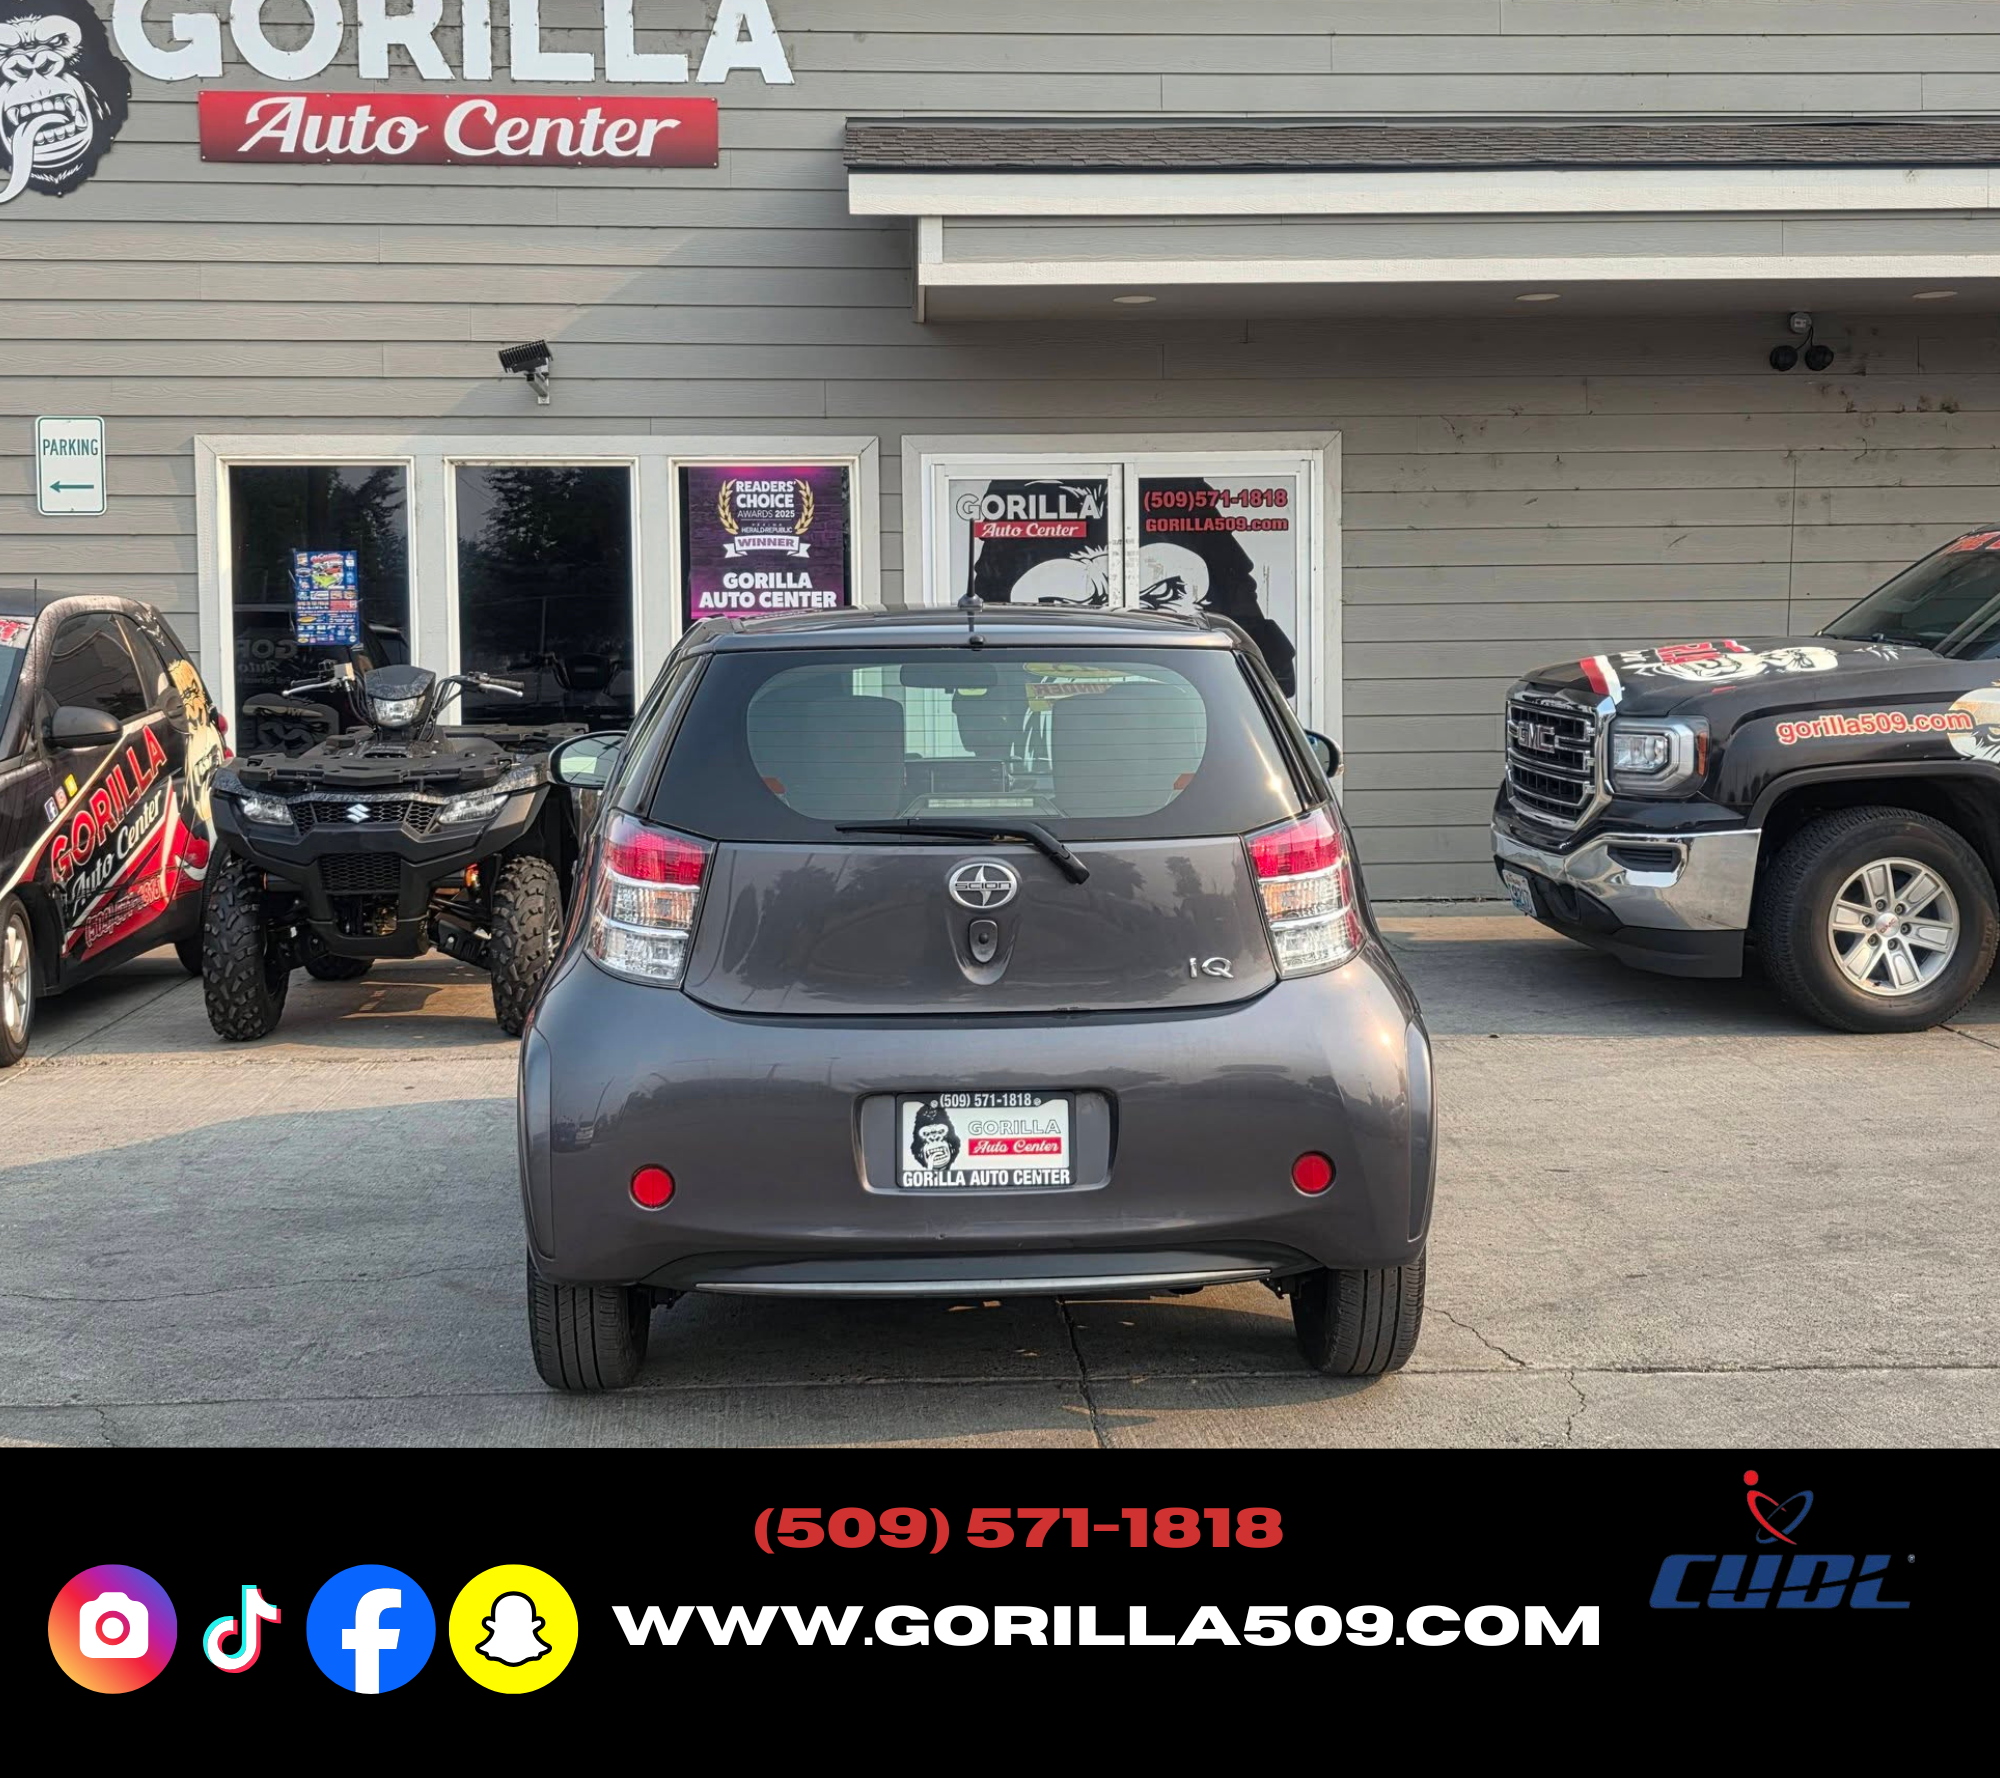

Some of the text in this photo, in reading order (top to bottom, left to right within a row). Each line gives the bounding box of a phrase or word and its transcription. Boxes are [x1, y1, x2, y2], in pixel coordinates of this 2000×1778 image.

[112, 0, 796, 85] GORILLA
[237, 96, 682, 159] Auto Center
[43, 438, 99, 456] PARKING
[736, 480, 797, 493] READERS'
[736, 494, 795, 508] CHOICE
[956, 494, 1101, 521] GORILLA
[1143, 488, 1289, 512] (509)571-1818
[737, 509, 796, 518] AWARDS 2025
[981, 522, 1080, 538] Auto Center
[1145, 516, 1289, 533] GORILLA509.com
[737, 537, 795, 547] WINNER
[722, 572, 813, 589] GORILLA
[698, 590, 838, 608] AUTO CENTER
[1518, 720, 1555, 754] GMC
[1776, 712, 1973, 745] gorilla509.com
[51, 724, 167, 883] GORILLA
[72, 789, 162, 917] Auto Center
[939, 1093, 1032, 1108] (509) 571-1818
[967, 1119, 1062, 1136] GORILLA
[973, 1138, 1059, 1154] Auto Center
[903, 1168, 1070, 1187] GORILLA AUTO CENTER
